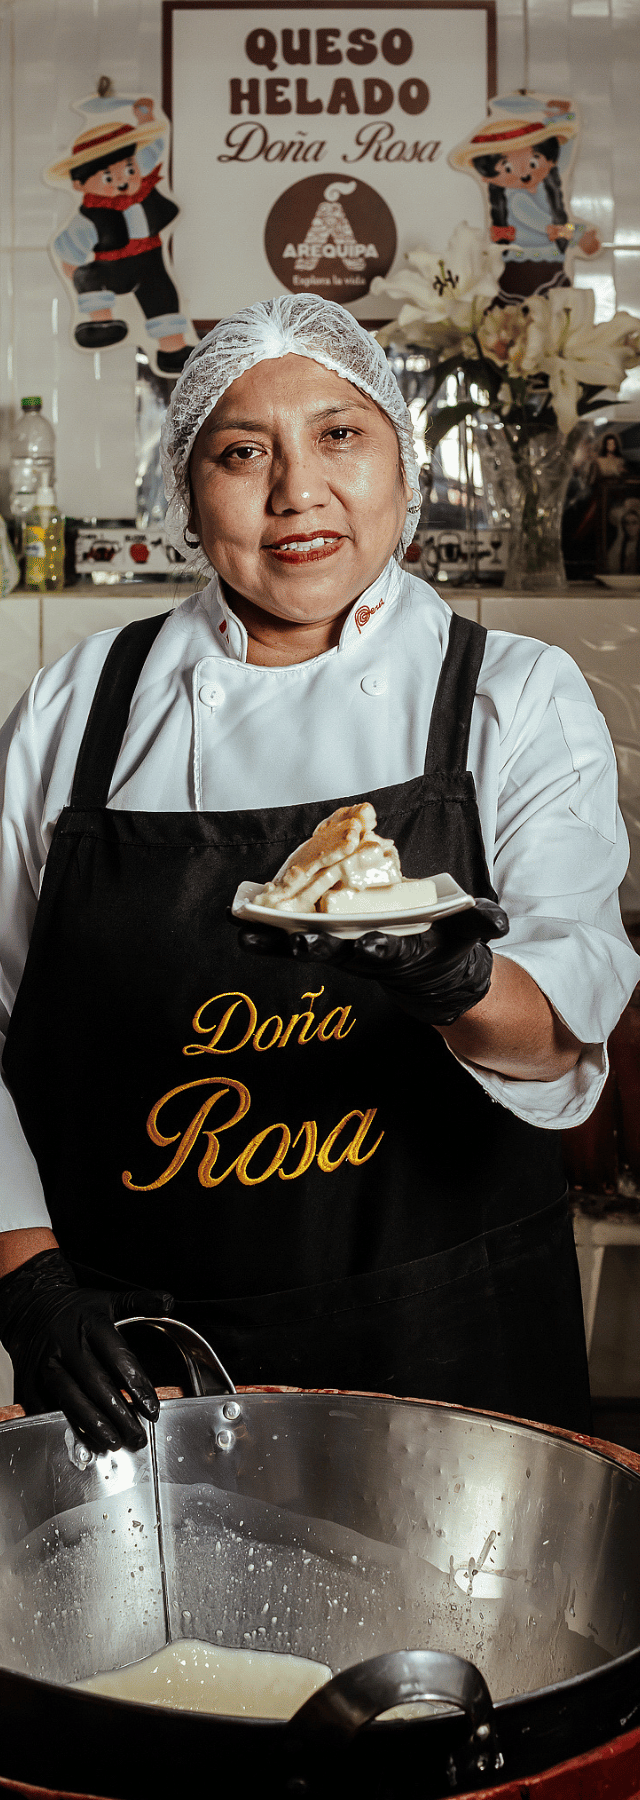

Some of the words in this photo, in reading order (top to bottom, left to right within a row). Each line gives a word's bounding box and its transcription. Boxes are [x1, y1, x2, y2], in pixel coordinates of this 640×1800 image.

[245, 28, 414, 71] QUESO
[229, 77, 430, 116] HELADO
[217, 121, 328, 163] Doña
[341, 121, 442, 163] Rosa
[282, 243, 379, 259] AREQUIPA
[292, 274, 332, 288] Explora
[332, 274, 343, 286] la
[343, 275, 367, 286] vida
[182, 985, 357, 1056] Doña
[121, 1076, 385, 1191] Rosa
